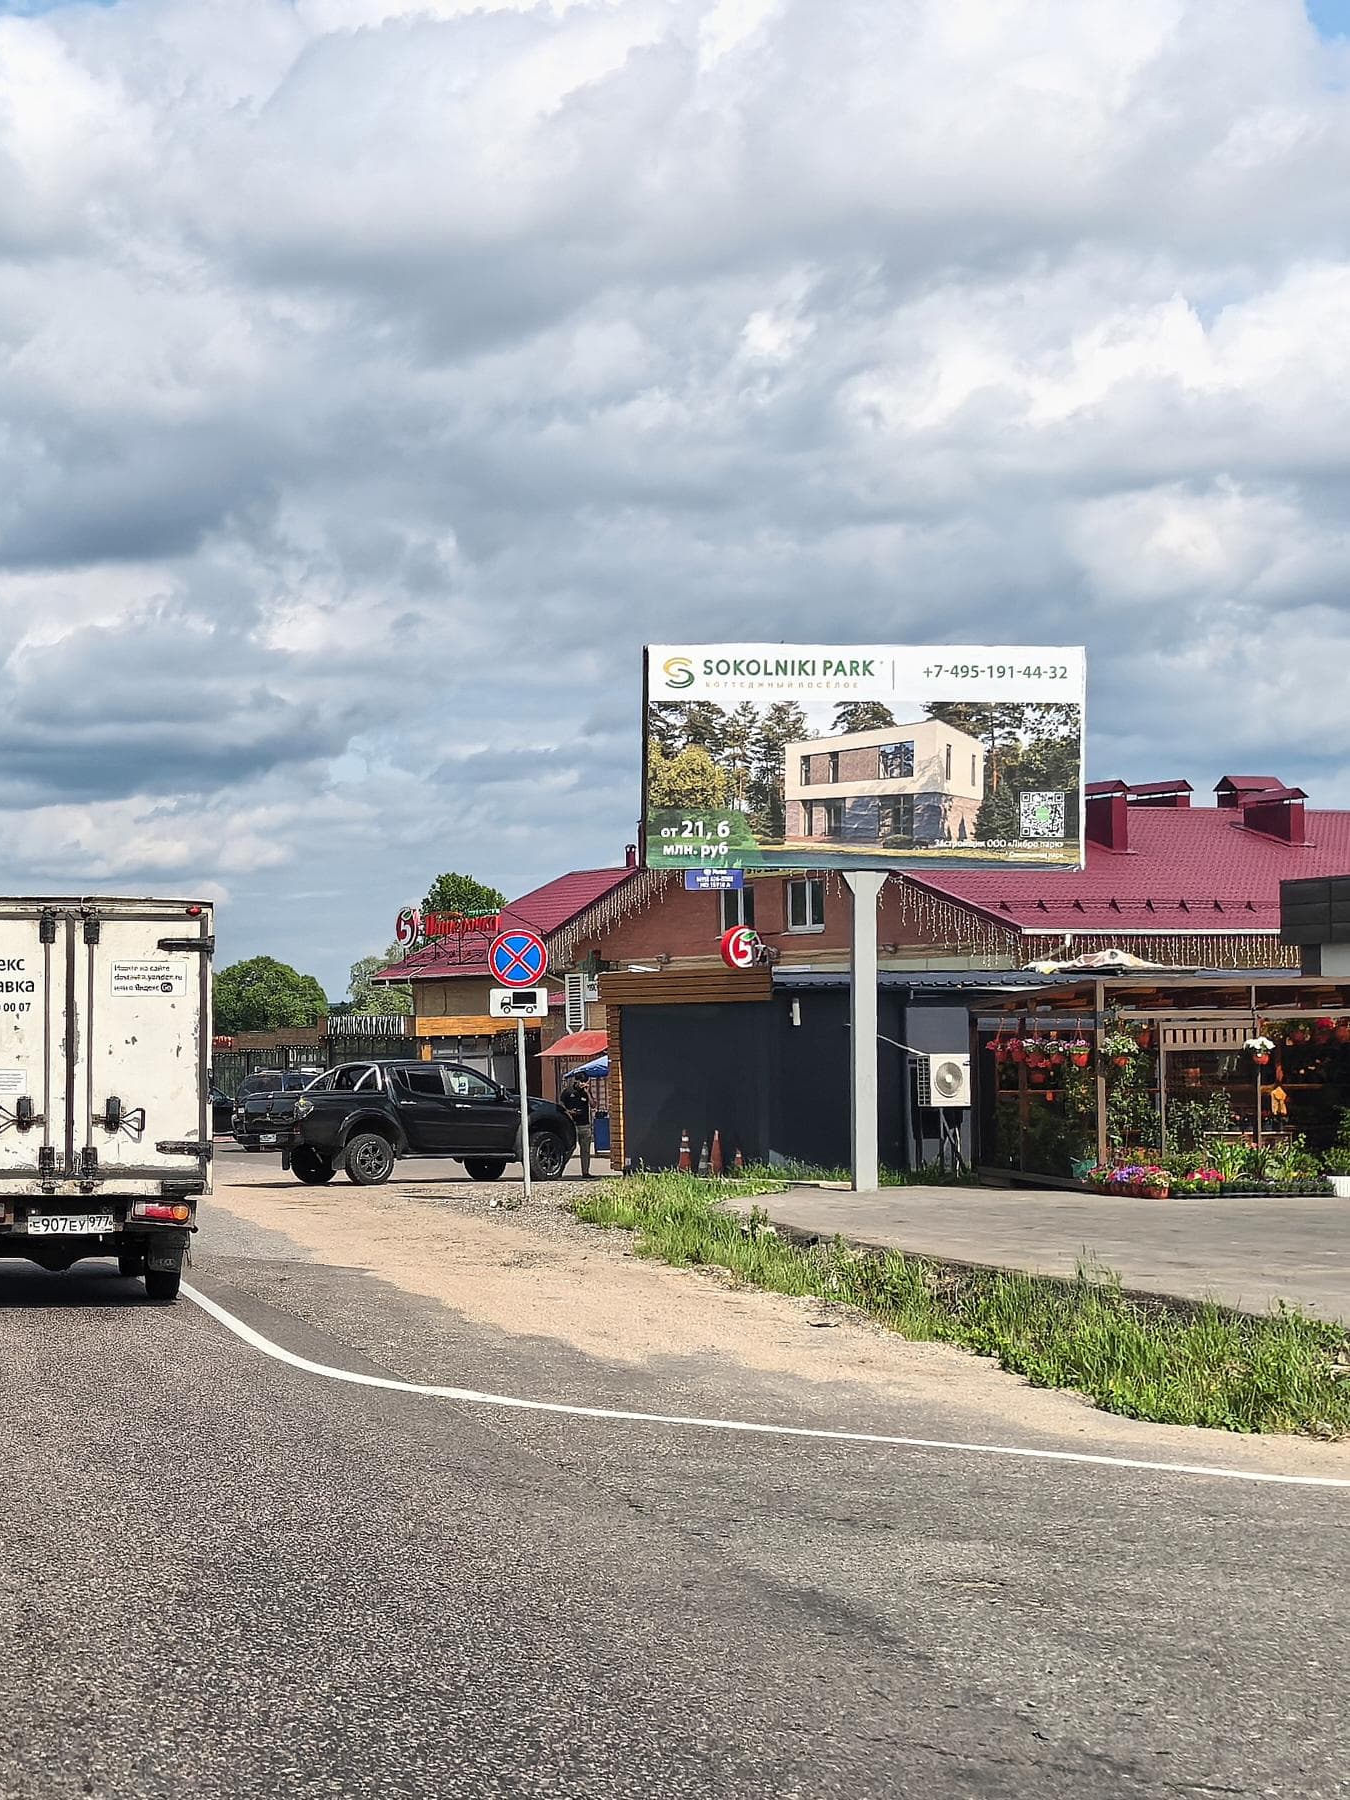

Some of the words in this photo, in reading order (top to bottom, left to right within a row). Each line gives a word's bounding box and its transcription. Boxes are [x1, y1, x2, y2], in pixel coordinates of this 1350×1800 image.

[703, 659, 816, 676] SOKOLNIKI
[822, 660, 875, 676] PARK
[923, 664, 1068, 679] +7-495-191-44-32
[661, 827, 679, 838] от
[987, 838, 1006, 848] ООО
[663, 845, 698, 856] млн.
[700, 842, 729, 858] руб
[3, 1003, 16, 1012] 00
[18, 1003, 31, 1012] 07
